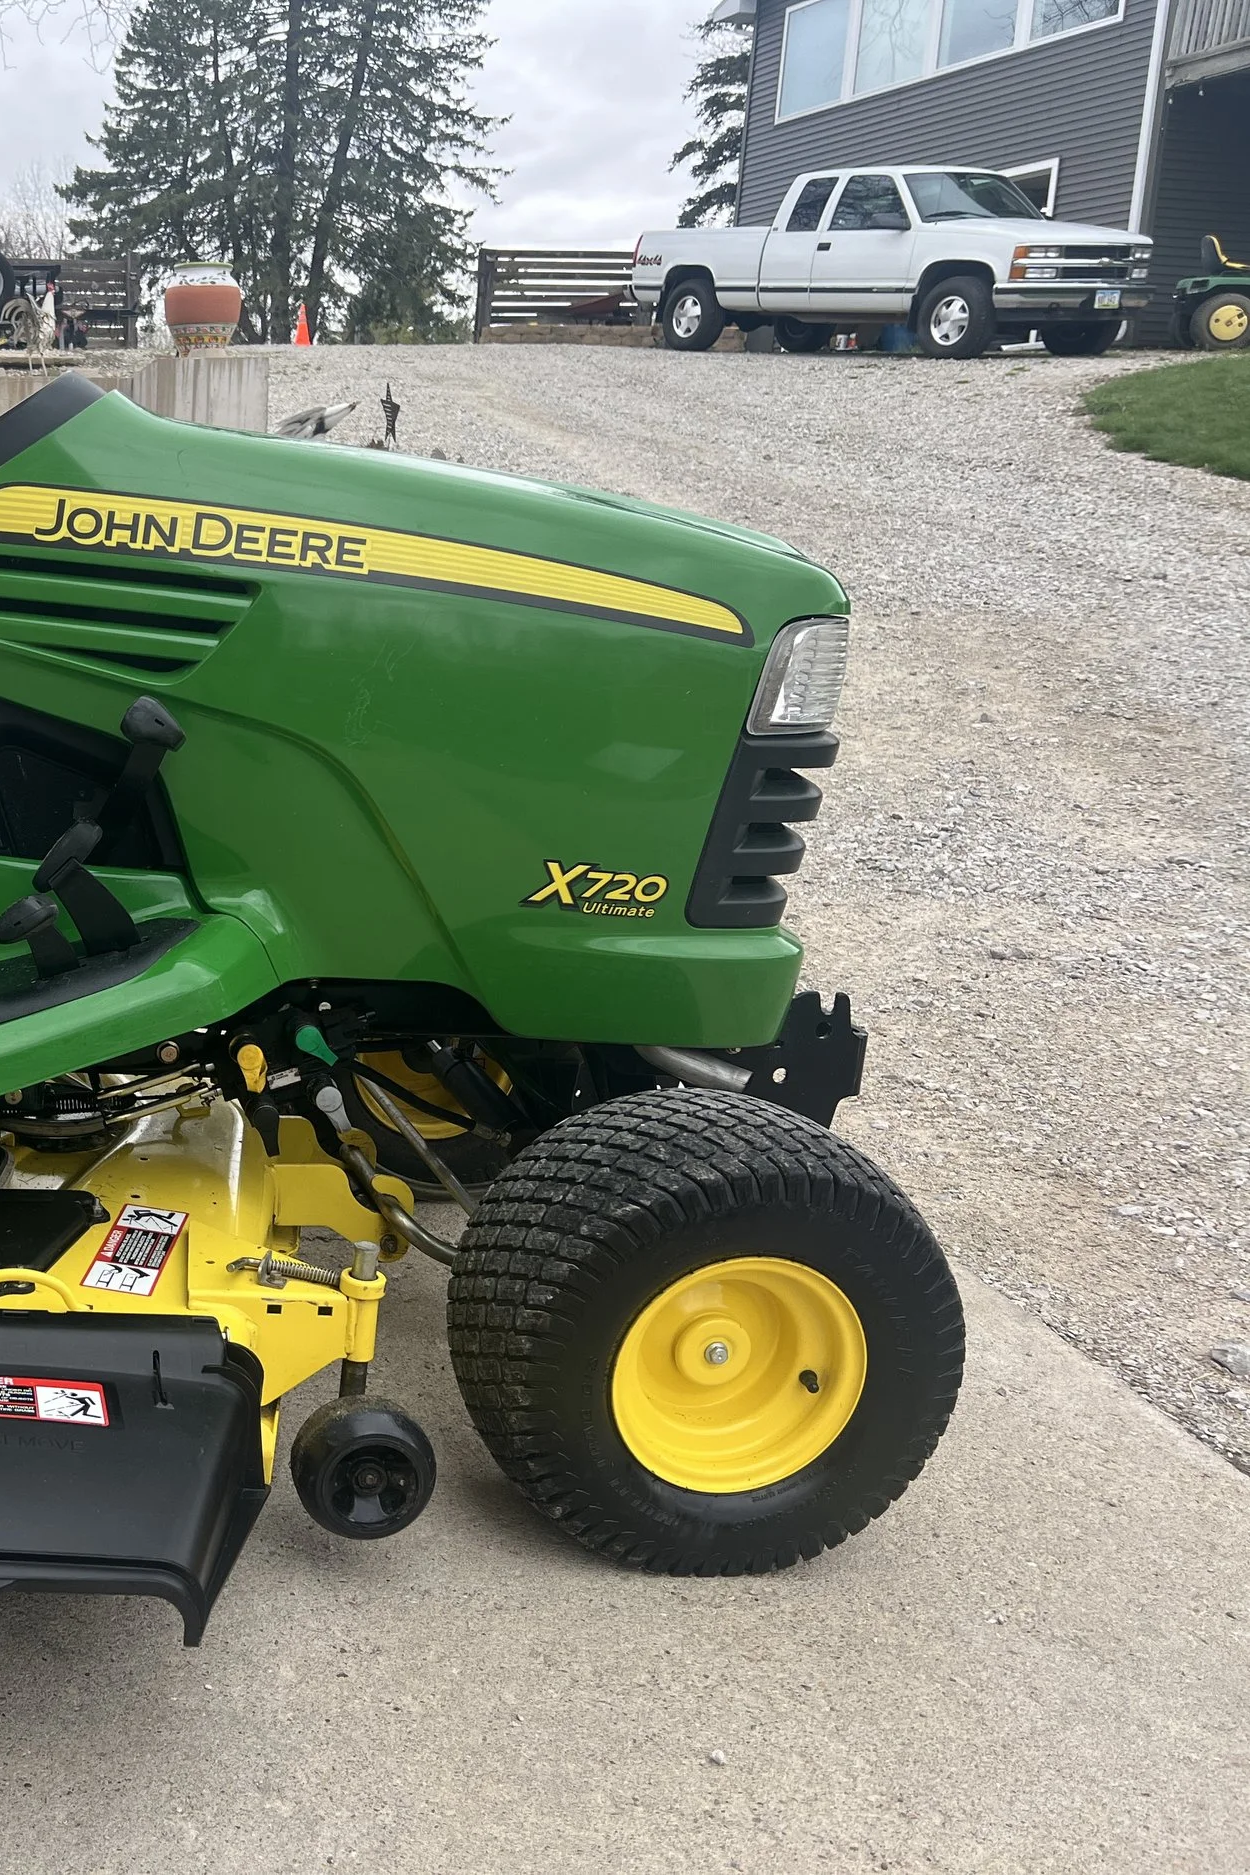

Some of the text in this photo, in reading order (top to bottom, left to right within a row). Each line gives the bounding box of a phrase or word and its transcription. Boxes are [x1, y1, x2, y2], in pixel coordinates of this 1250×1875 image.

[35, 497, 368, 571] JOHN DEERE
[521, 858, 669, 908] X720
[582, 901, 656, 919] Ultimate
[103, 1229, 124, 1251] DANGER
